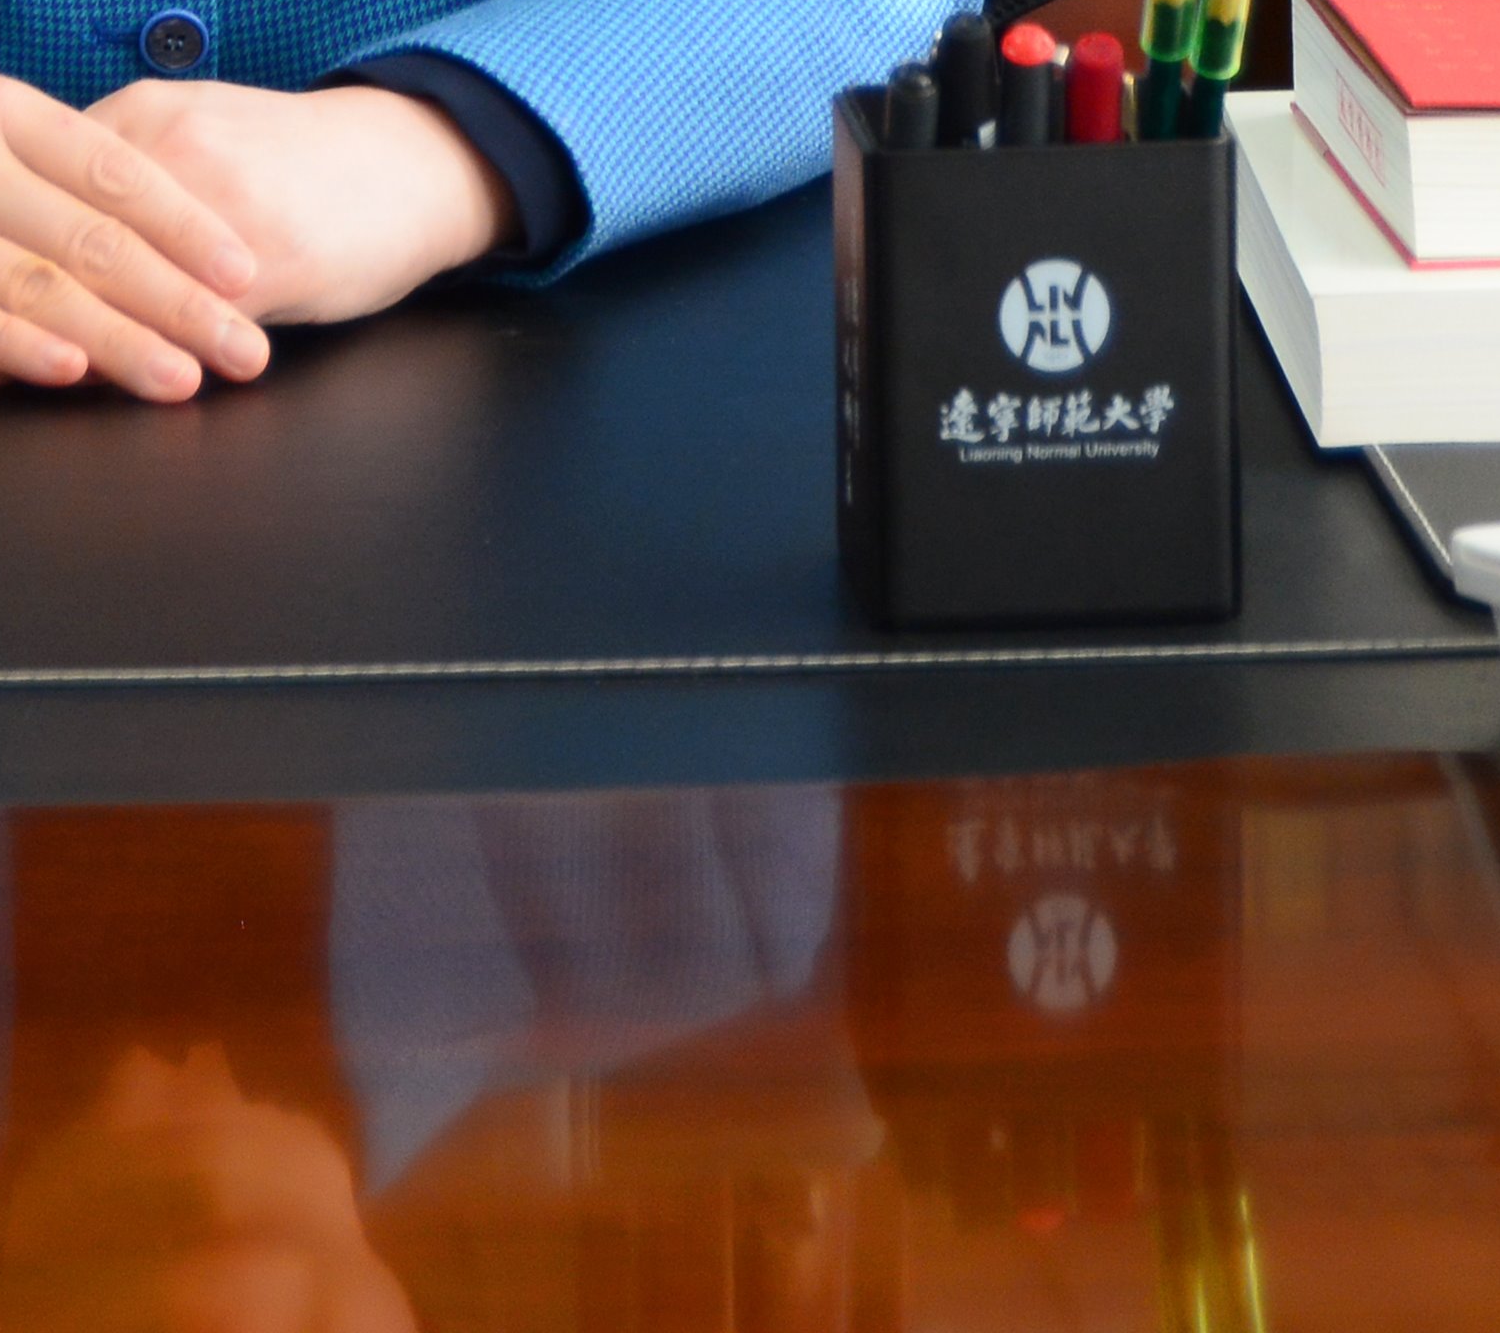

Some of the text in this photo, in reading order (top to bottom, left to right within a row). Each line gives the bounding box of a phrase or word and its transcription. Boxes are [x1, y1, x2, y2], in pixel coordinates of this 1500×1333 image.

[960, 441, 1160, 463] Liaoning Normal University
